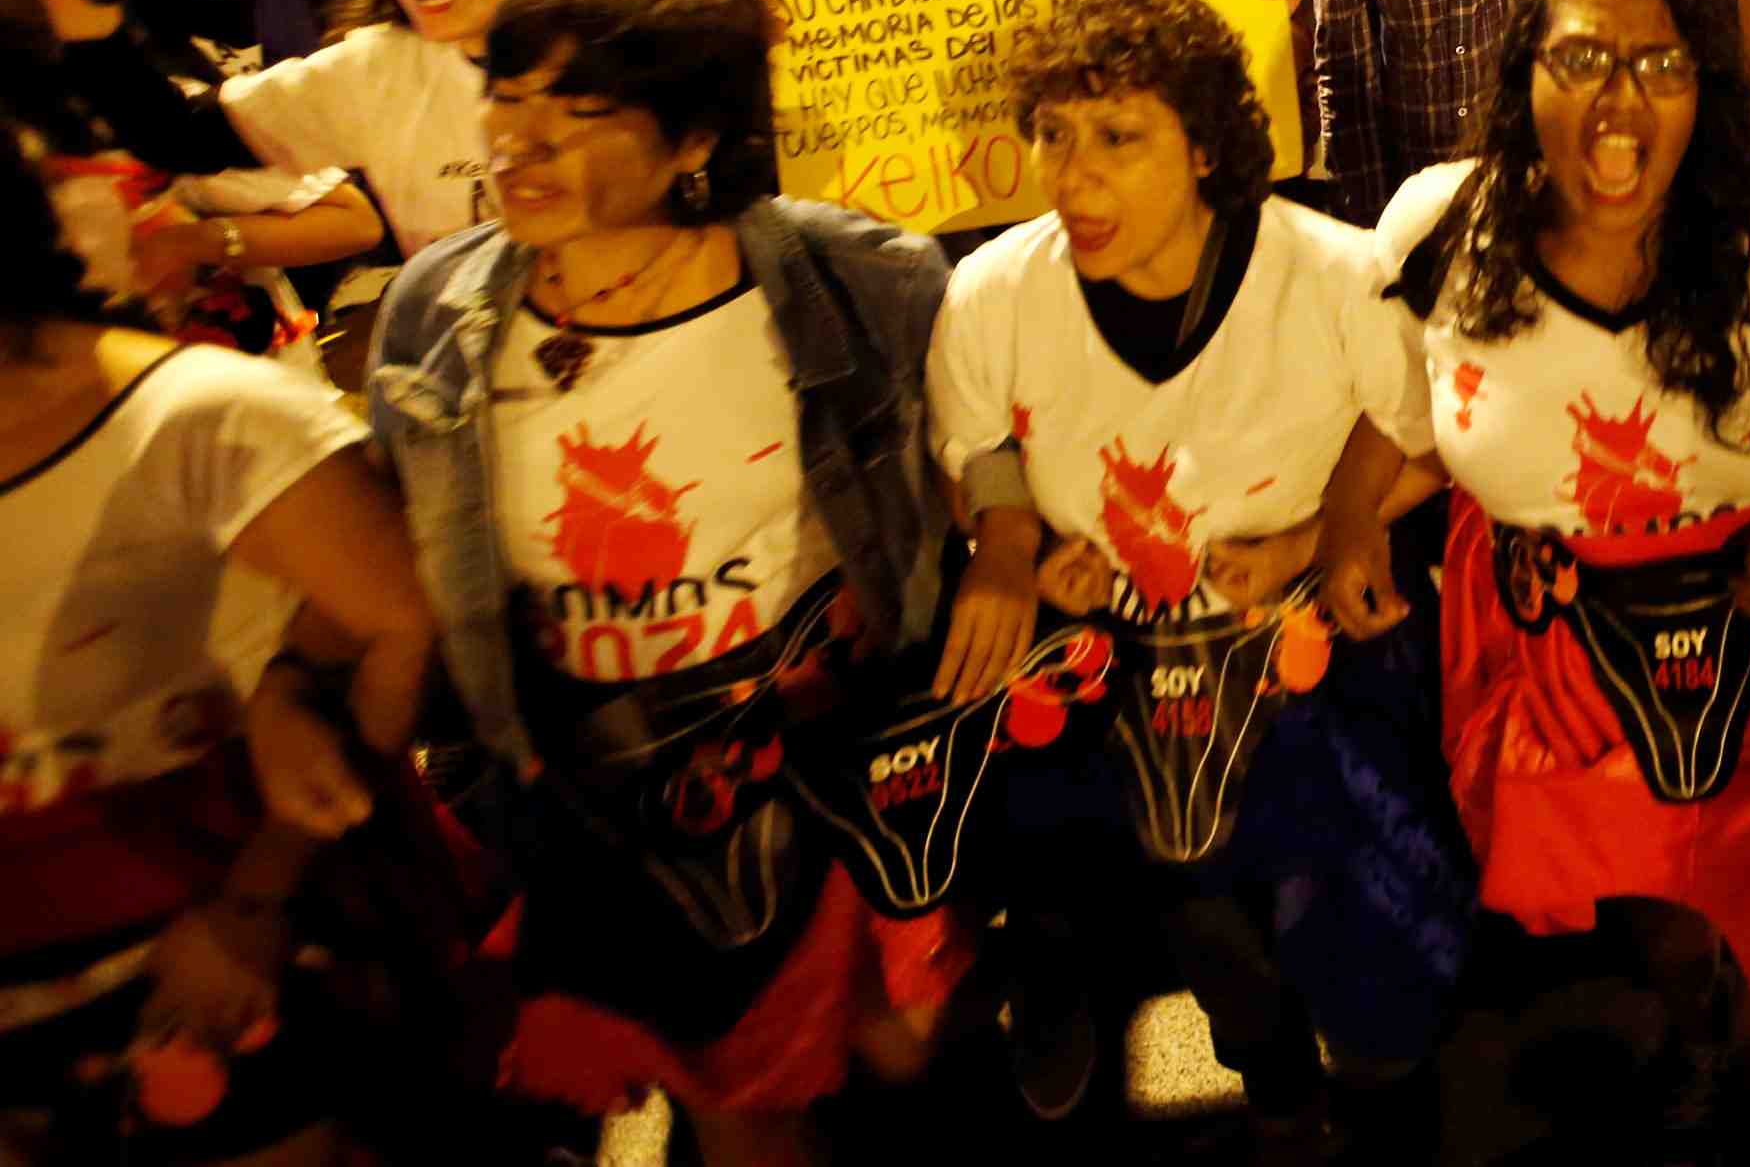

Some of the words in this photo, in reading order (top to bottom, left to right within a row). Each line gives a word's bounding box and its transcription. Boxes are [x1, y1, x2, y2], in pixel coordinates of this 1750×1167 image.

[799, 80, 853, 121] HAY
[1653, 624, 1709, 661] SOY
[1151, 664, 1206, 700] SOY
[869, 735, 941, 783] SOY
